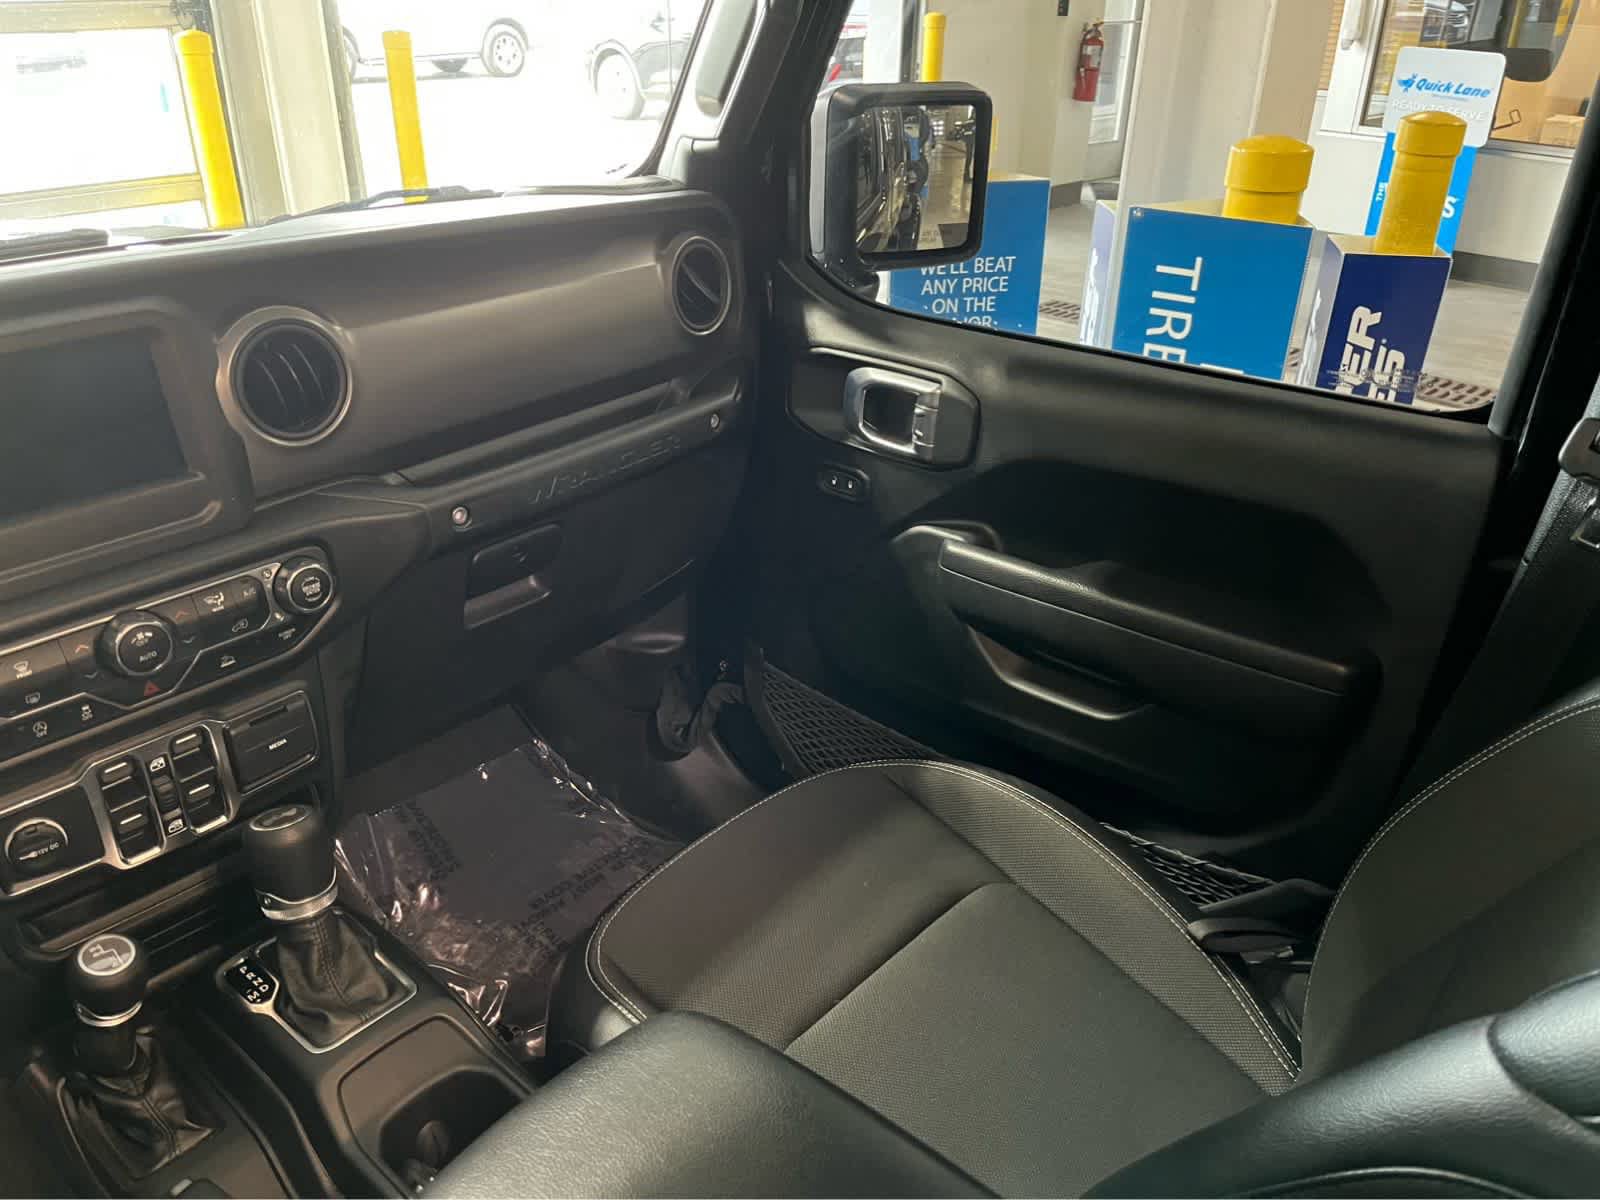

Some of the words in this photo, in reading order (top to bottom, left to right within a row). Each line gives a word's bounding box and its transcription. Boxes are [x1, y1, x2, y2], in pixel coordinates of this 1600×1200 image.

[1416, 78, 1454, 93] Quick
[1454, 82, 1491, 98] Lane
[920, 261, 968, 276] WELL
[974, 256, 1016, 274] BEAT
[920, 278, 958, 296] ANY
[962, 276, 1009, 294] PRICE
[932, 298, 958, 314] ON
[963, 296, 997, 313] THE
